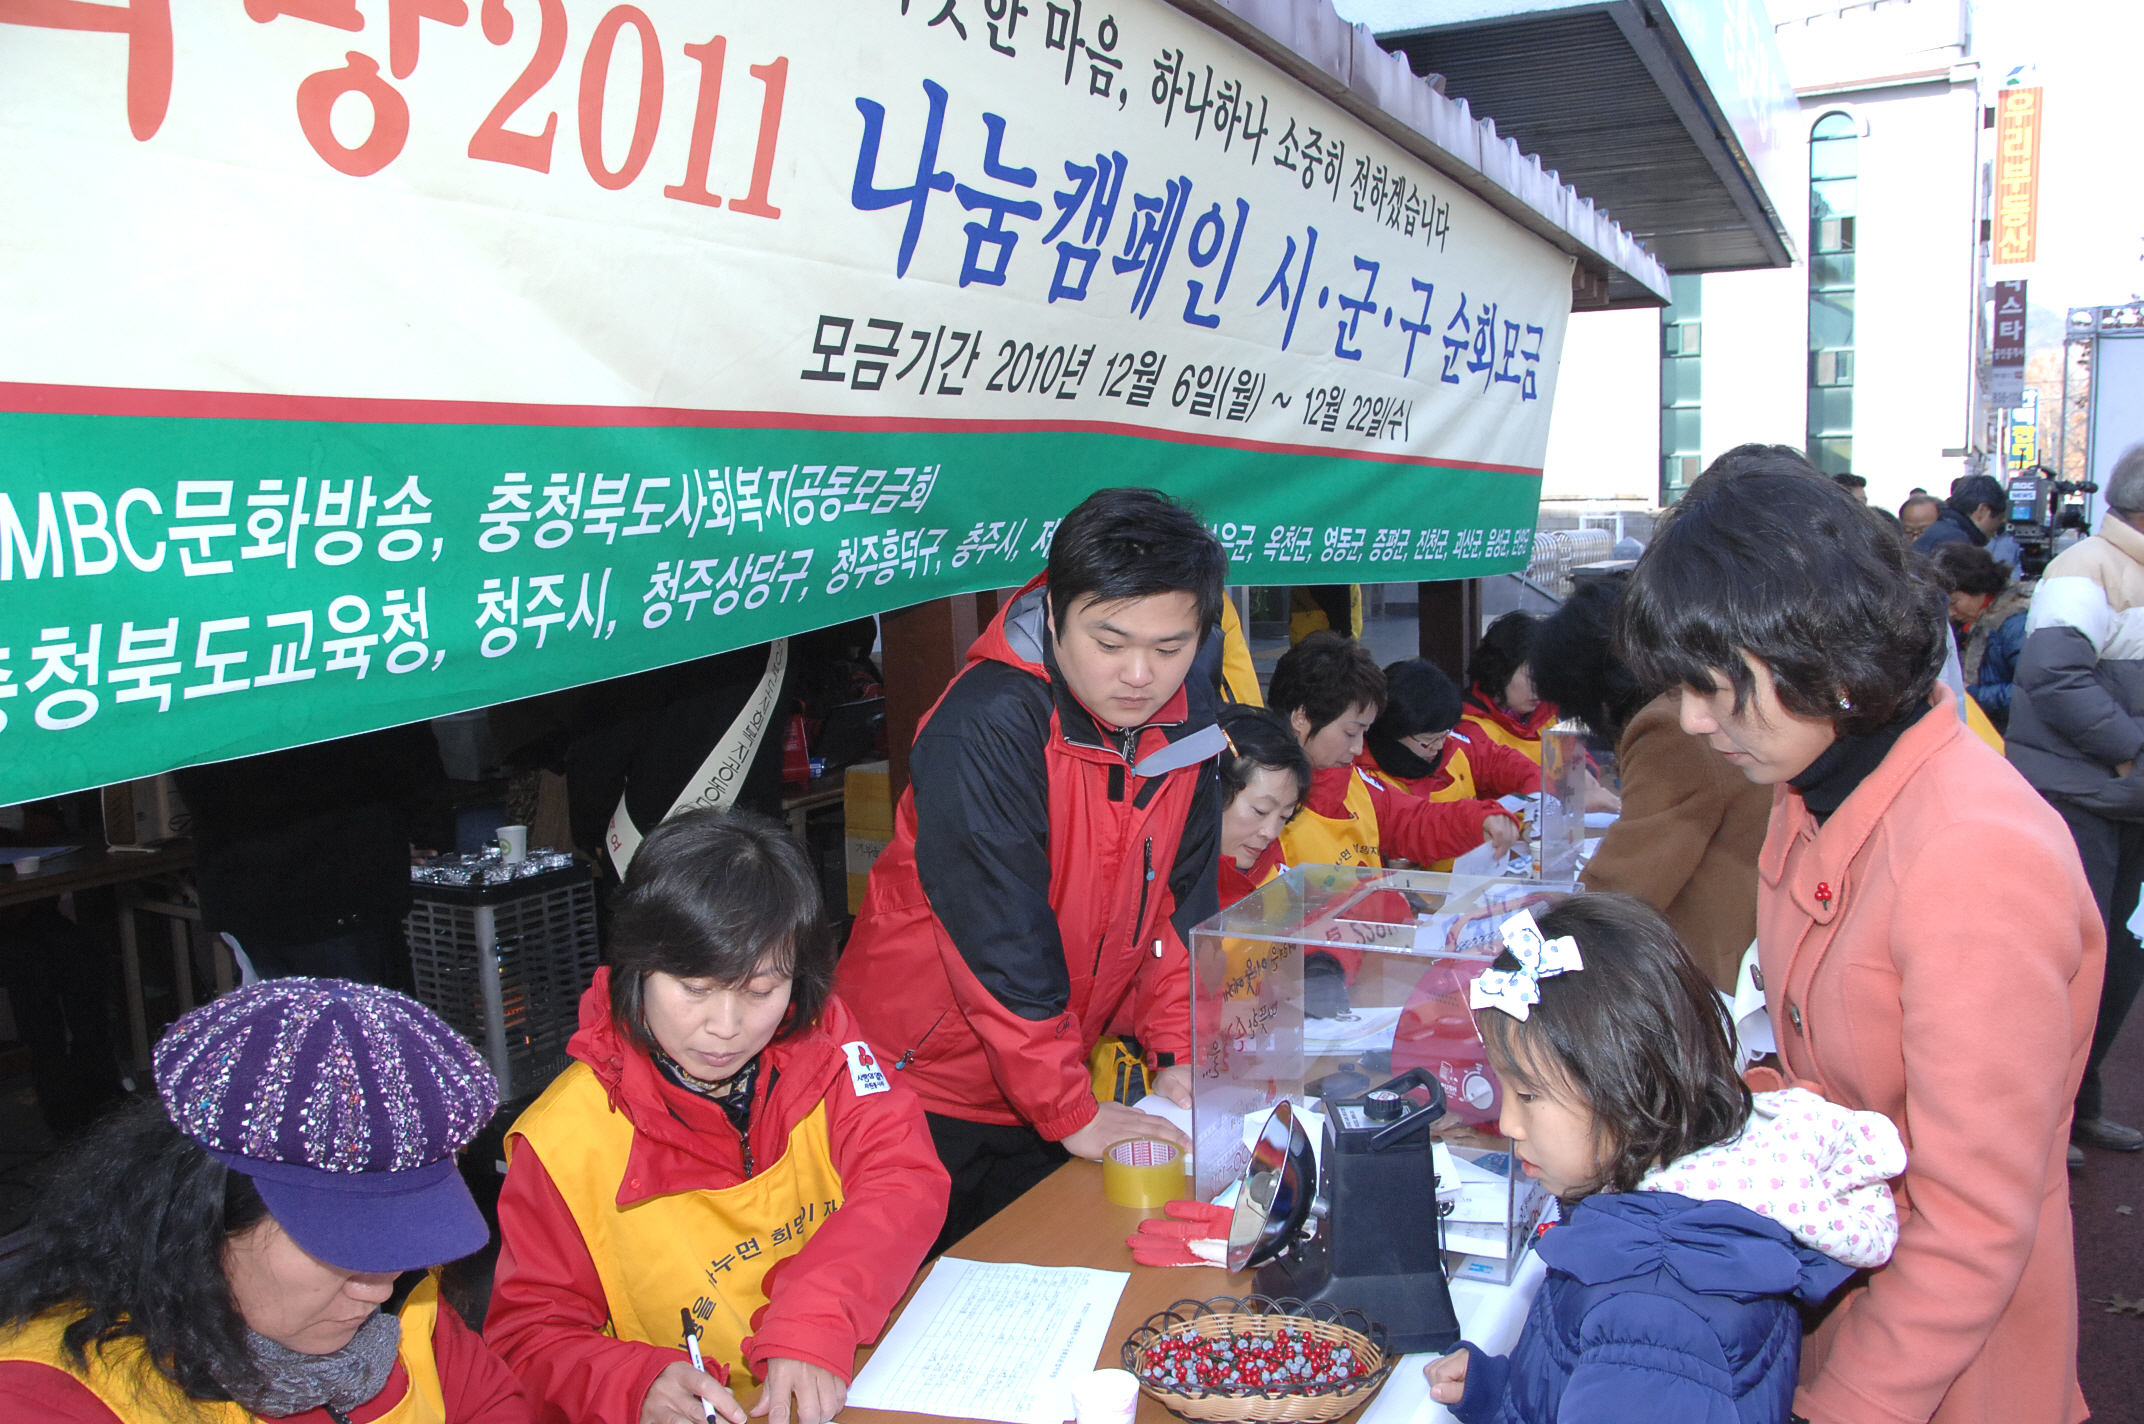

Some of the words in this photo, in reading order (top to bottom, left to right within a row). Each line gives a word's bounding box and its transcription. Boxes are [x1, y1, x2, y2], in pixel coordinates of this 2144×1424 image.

[1045, 0, 1128, 112] 마음,
[1151, 48, 1269, 166] 하나하나
[1273, 116, 1346, 203] 소중히
[1350, 155, 1450, 254] 전하겠습니다
[1998, 92, 2035, 260] 우리부동산
[851, 78, 1250, 330] 나눔캠페인
[1441, 291, 1544, 402] 순회모금
[800, 314, 982, 396] 모금기간
[985, 338, 1097, 400] 2010년
[1098, 349, 1168, 408] 12월
[1171, 363, 1267, 423] 6일(월)
[1303, 386, 1347, 433] 12월
[0, 474, 444, 581] MBC문화방송,
[477, 463, 942, 554] 충청북도사회복지공동모금회
[474, 566, 618, 659] 청주시,
[642, 549, 815, 630] 청주상당구,
[825, 526, 948, 595] 청주흥덕구,
[951, 517, 1028, 568] 충주시,
[1263, 524, 1314, 564] 옥천군,
[1320, 526, 1367, 563] 영동군,
[1369, 528, 1412, 562] 증평군,
[1413, 528, 1451, 562] 진천군,
[1452, 528, 1484, 560] 괴산군,
[1484, 528, 1512, 558] 음성군,
